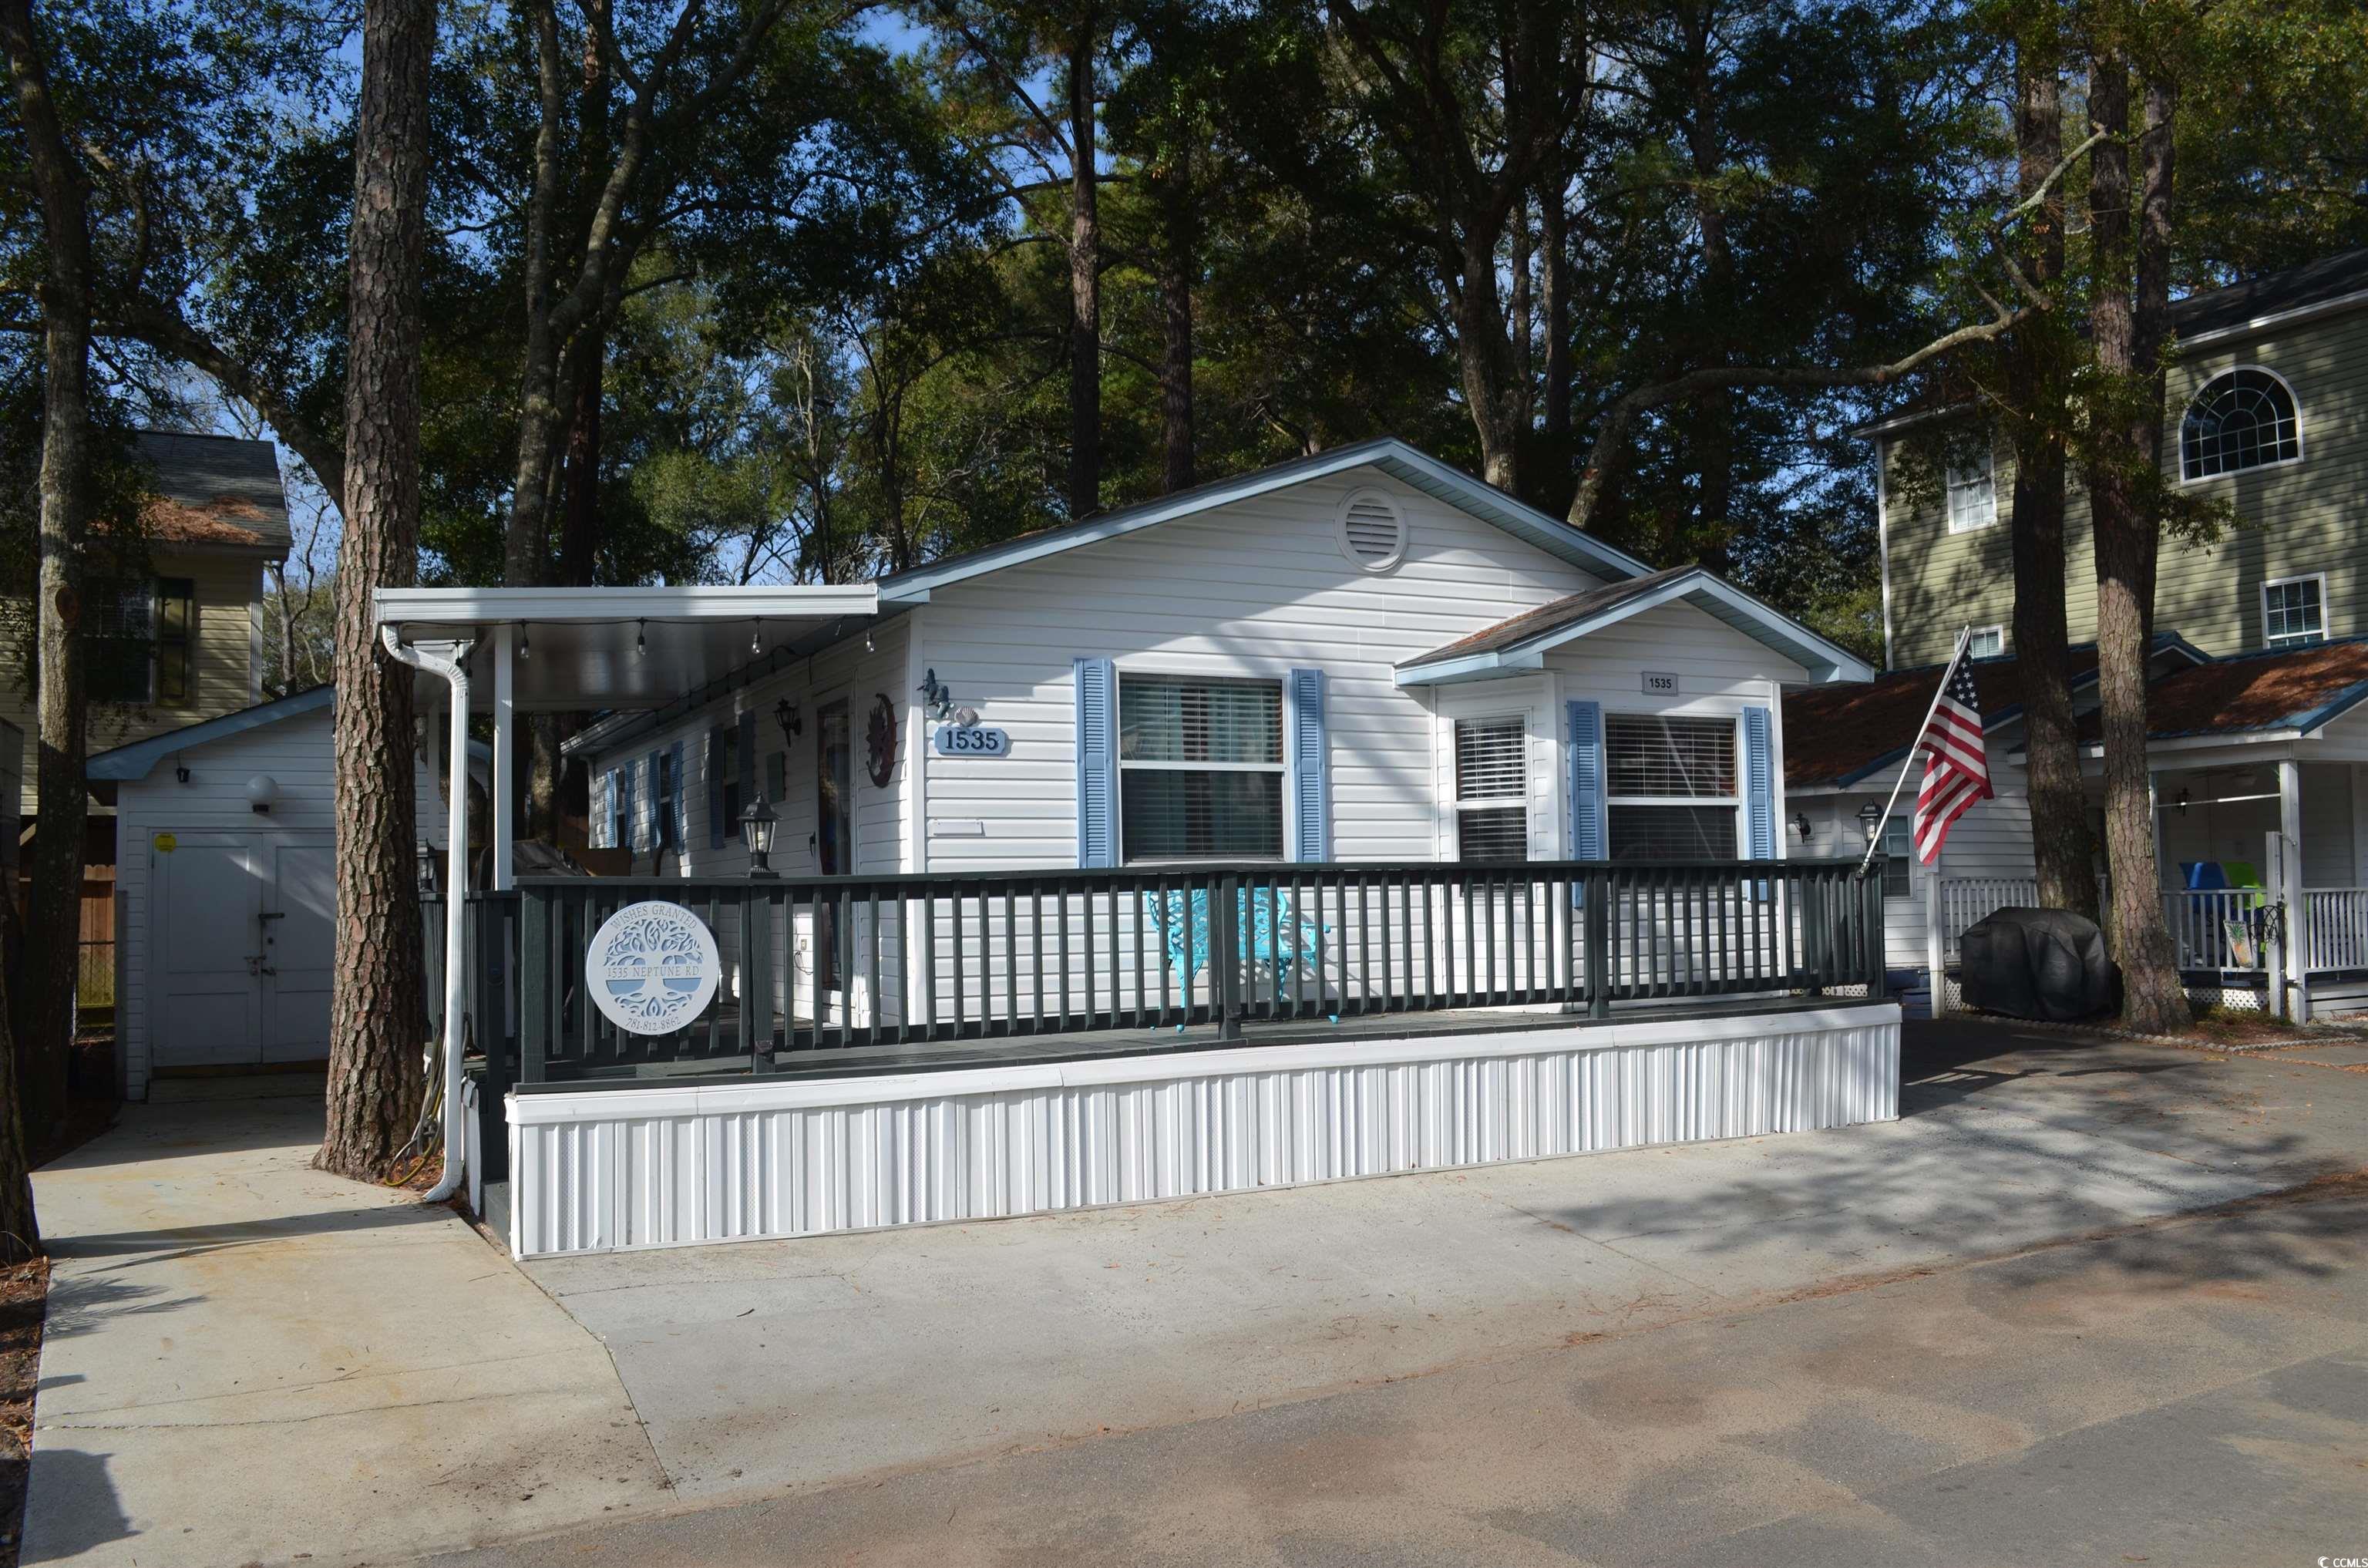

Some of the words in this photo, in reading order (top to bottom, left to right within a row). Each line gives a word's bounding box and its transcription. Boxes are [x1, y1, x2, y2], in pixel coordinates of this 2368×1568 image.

[1650, 678, 1672, 688] 1535
[945, 730, 999, 750] 1535
[610, 905, 648, 929] WISHES
[651, 904, 697, 929] GRANTED
[607, 967, 628, 978] 1535
[633, 966, 681, 977] NEPTUNE
[685, 965, 700, 976] RD
